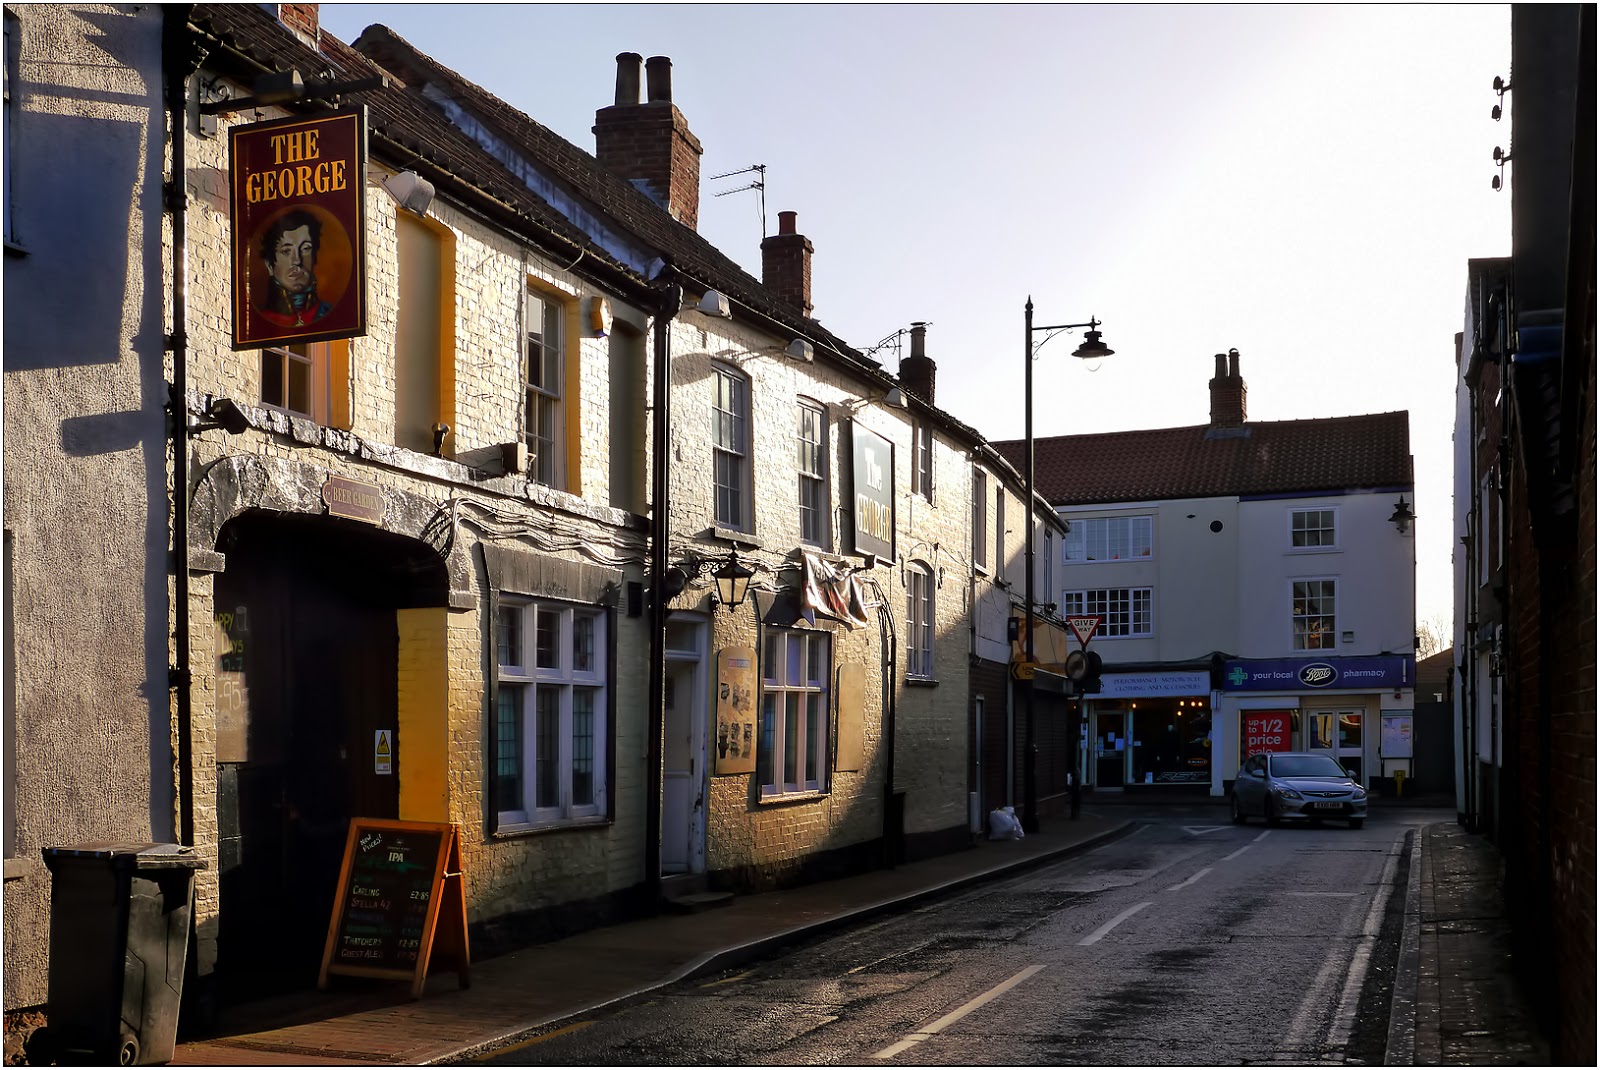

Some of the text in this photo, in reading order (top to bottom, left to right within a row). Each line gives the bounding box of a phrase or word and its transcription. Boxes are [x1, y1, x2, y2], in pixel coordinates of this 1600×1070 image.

[270, 129, 320, 165] THE
[246, 160, 347, 204] GEORGE
[333, 487, 379, 511] BEER GARDEN
[857, 492, 891, 543] GEORGE
[1074, 619, 1094, 627] GIVE
[1252, 667, 1386, 682] your local Boots pharmacy
[1260, 719, 1283, 733] 1/2
[1248, 734, 1282, 747] price
[1157, 771, 1209, 781] RST
[388, 852, 404, 862] IPA
